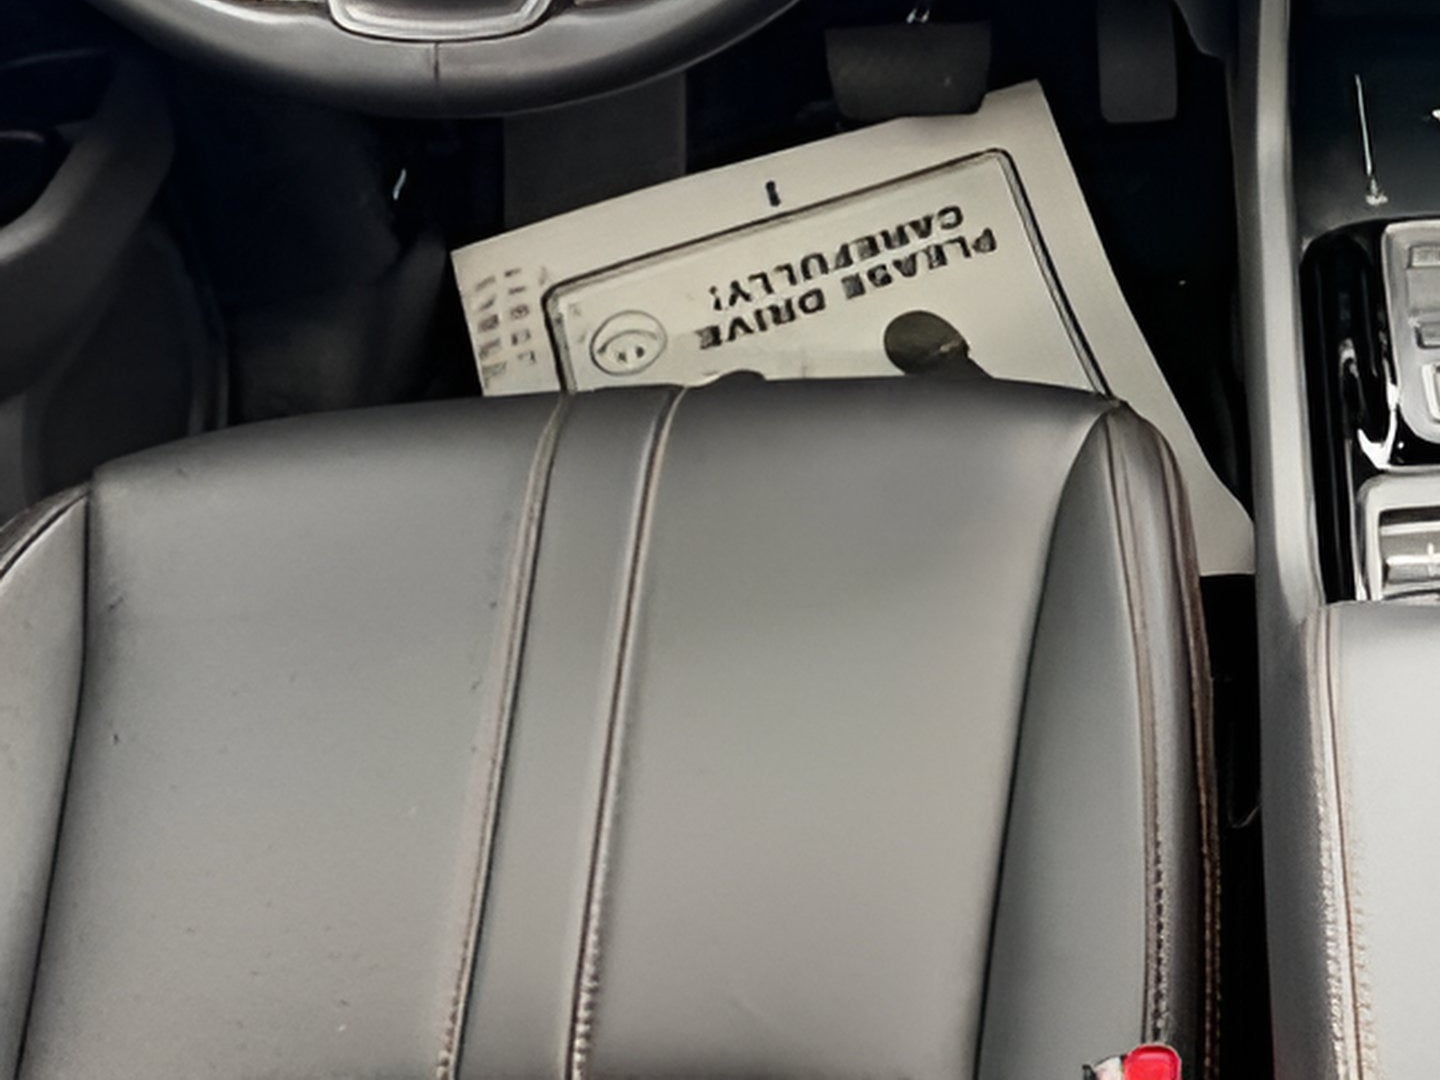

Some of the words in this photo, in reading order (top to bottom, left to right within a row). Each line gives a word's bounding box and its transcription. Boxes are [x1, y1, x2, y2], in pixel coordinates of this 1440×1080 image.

[708, 204, 965, 311] CAREFULLY!
[841, 227, 998, 300] PLEASE
[695, 287, 827, 350] DRIVE
